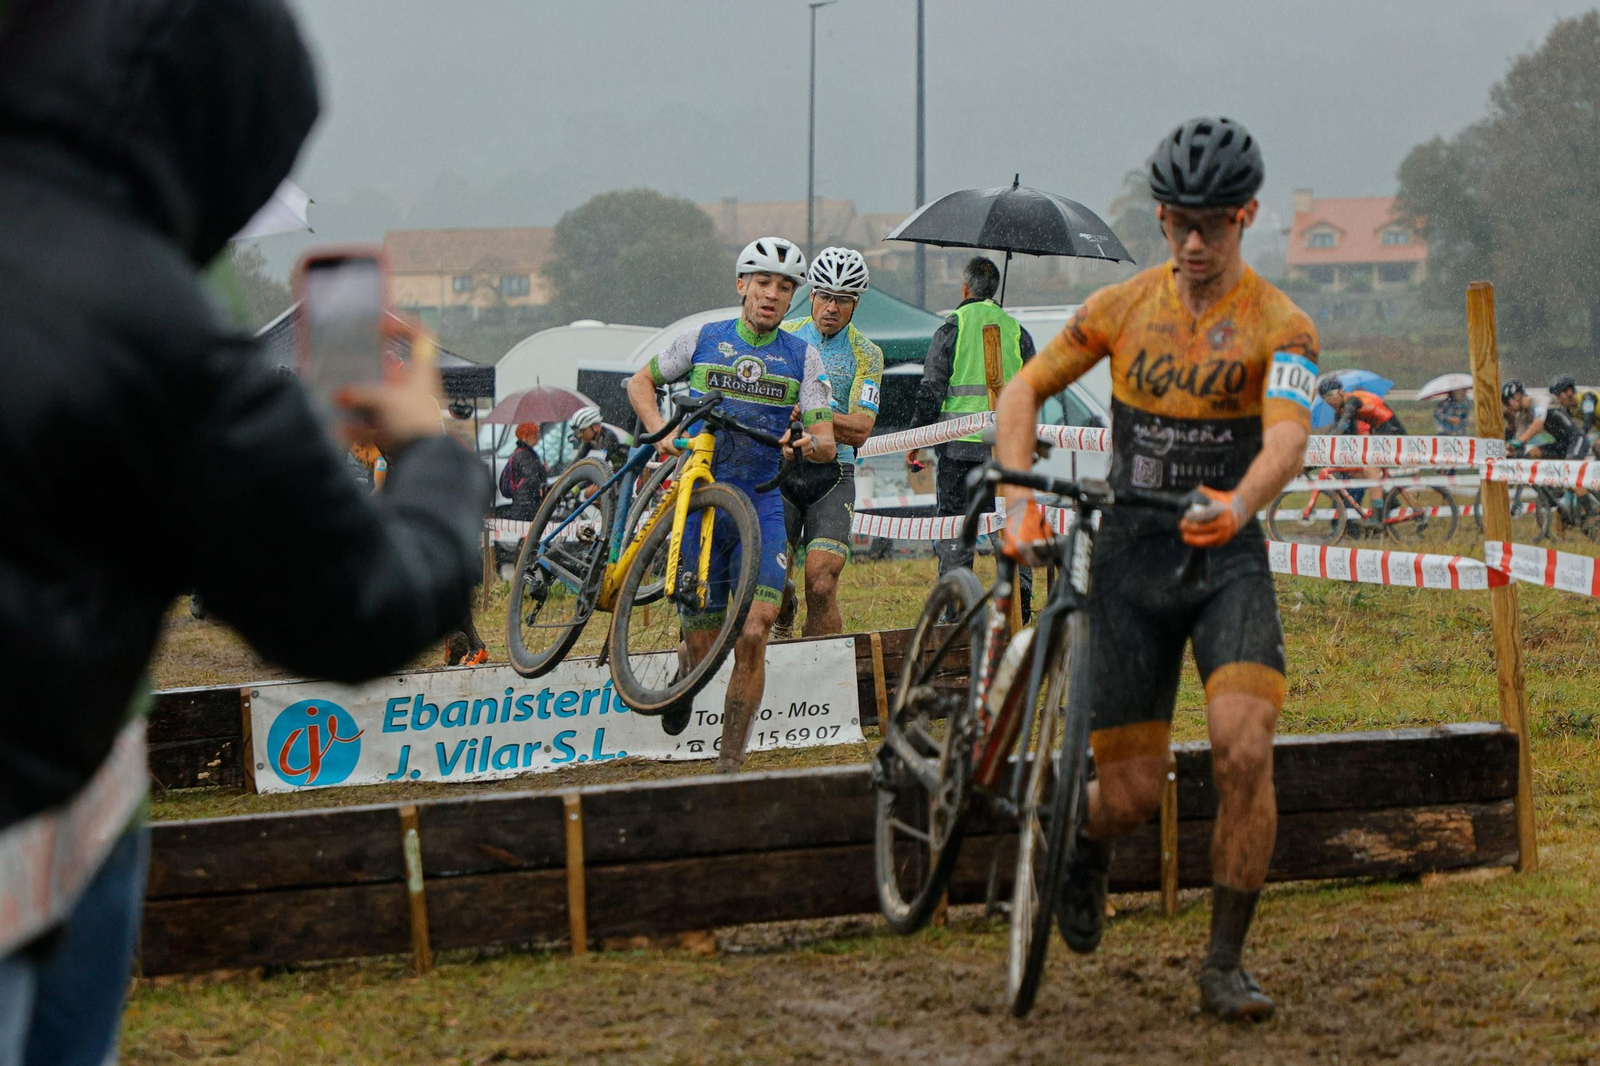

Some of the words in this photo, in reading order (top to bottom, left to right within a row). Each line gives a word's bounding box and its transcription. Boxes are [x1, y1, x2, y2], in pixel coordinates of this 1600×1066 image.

[708, 373, 720, 386] A
[722, 376, 784, 398] Rosaleira
[1276, 366, 1311, 399] 104
[788, 701, 830, 718] Mos
[757, 730, 780, 746] 15
[785, 727, 811, 742] 69
[816, 725, 841, 740] 07
[386, 744, 422, 780] J.
[435, 735, 542, 777] Vilar
[550, 727, 628, 763] S.L.
